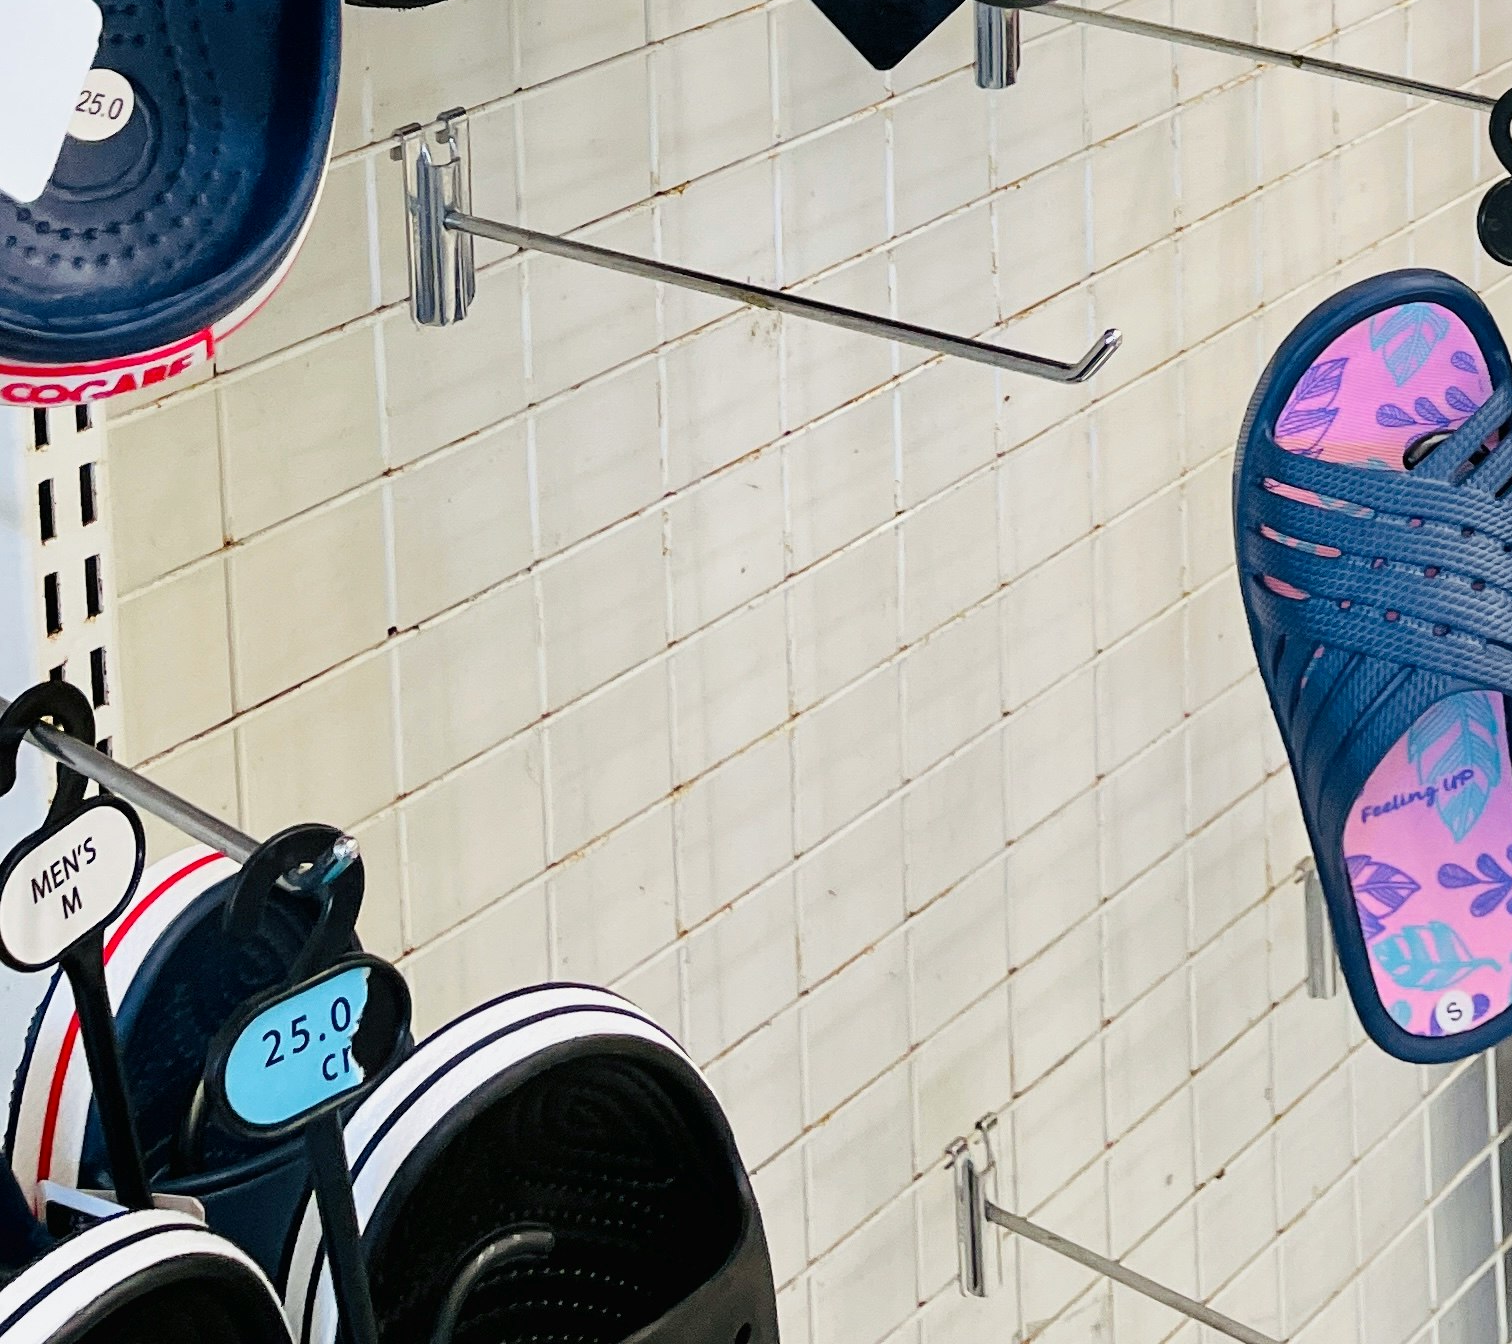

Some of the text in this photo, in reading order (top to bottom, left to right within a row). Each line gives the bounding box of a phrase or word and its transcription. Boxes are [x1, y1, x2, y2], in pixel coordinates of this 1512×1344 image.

[76, 88, 124, 120] 25.0
[30, 836, 99, 905] MEN'S
[61, 884, 83, 921] M
[1446, 1001, 1463, 1022] S
[261, 994, 352, 1071] 25.0
